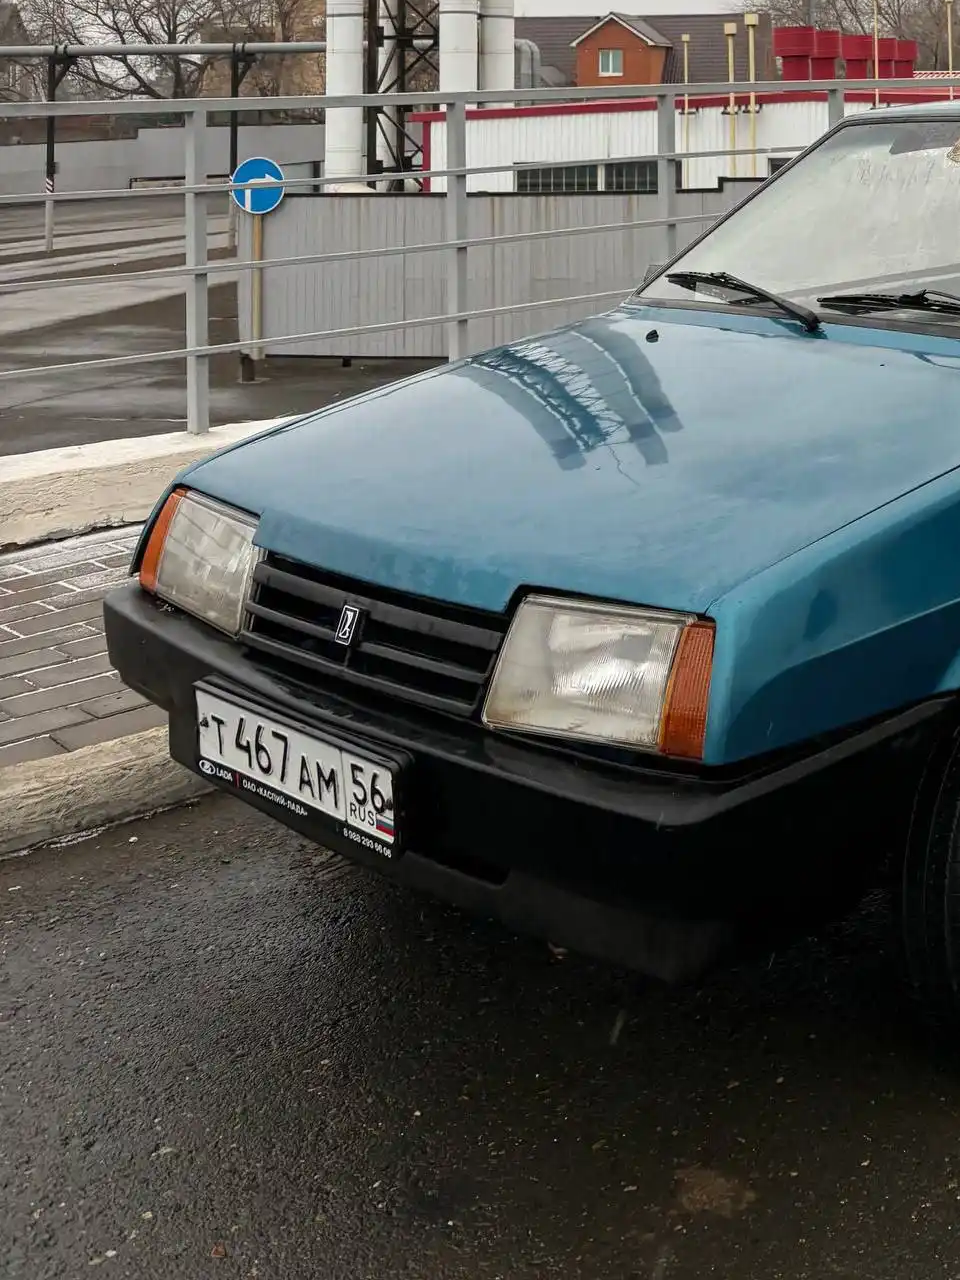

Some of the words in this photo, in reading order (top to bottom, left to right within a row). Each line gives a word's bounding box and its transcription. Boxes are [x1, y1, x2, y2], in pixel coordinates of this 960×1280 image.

[216, 768, 233, 782] LADA
[242, 779, 257, 793] ОАО
[350, 802, 375, 826] RUS
